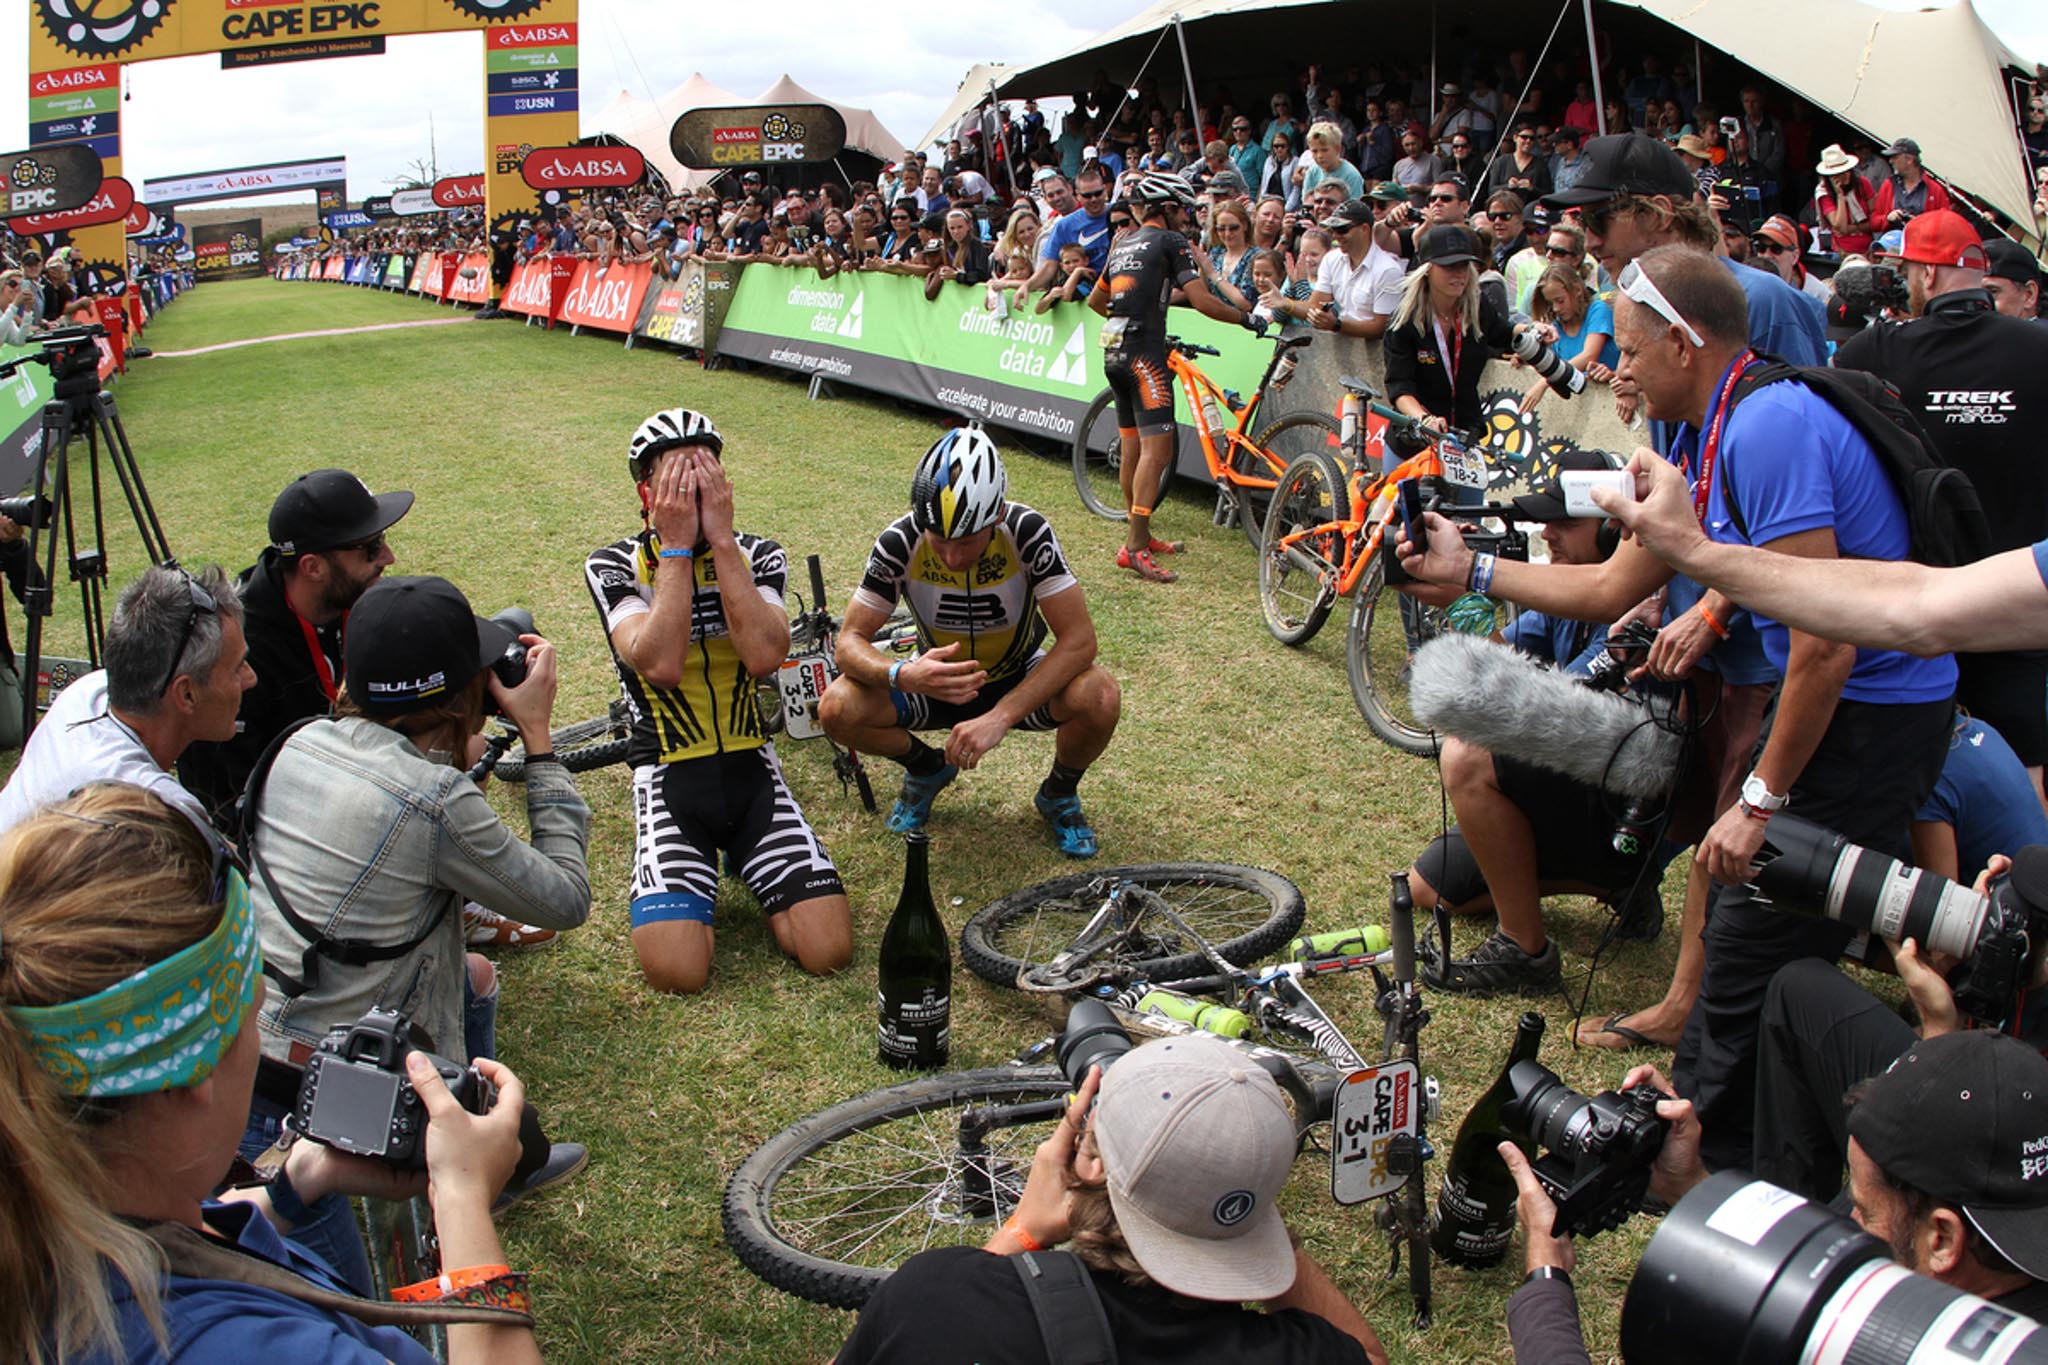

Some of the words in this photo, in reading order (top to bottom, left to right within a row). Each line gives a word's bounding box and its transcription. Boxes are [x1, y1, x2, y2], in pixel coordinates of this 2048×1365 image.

[222, 9, 303, 40] CAPE
[310, 2, 380, 32] EPIC
[524, 28, 569, 41] ABSA
[236, 52, 259, 62] Stage
[61, 70, 106, 87] ABSA
[526, 97, 554, 109] USN
[731, 131, 757, 140] ABSA
[712, 145, 760, 162] CAPE
[762, 143, 805, 161] EPIC
[497, 161, 522, 174] EPI
[571, 160, 627, 177] ABSA
[238, 175, 272, 187] ABSA
[11, 188, 56, 211] EPIC
[195, 254, 229, 269] CAPE
[230, 251, 259, 266] EPIC
[708, 281, 730, 290] EPIC
[582, 280, 633, 321] ABSA
[787, 284, 845, 309] dimension
[647, 314, 675, 339] CAPE
[671, 317, 697, 341] EPIC
[810, 312, 838, 334] data
[959, 306, 1054, 346] dimension
[770, 348, 802, 368] accelerate
[801, 353, 818, 371] your
[817, 356, 853, 376] ambition
[999, 344, 1046, 377] data
[1928, 391, 2014, 404] TREK
[937, 384, 988, 412] accelerate
[988, 399, 1018, 420] your
[1018, 404, 1075, 436] ambition
[1945, 413, 2003, 424] marco
[1961, 405, 1992, 414] san
[922, 570, 958, 586] ABSA
[976, 571, 1004, 586] EPIC
[368, 671, 445, 692] BULLS
[800, 665, 816, 700] CAPE
[785, 684, 804, 718] 3-2
[637, 787, 656, 888] BULLS
[805, 878, 835, 888] CRAFT
[1372, 1075, 1392, 1136] CAPE
[1395, 1094, 1406, 1128] ABSA
[1343, 1114, 1369, 1164] 3-1
[1369, 1137, 1390, 1189] EPIC
